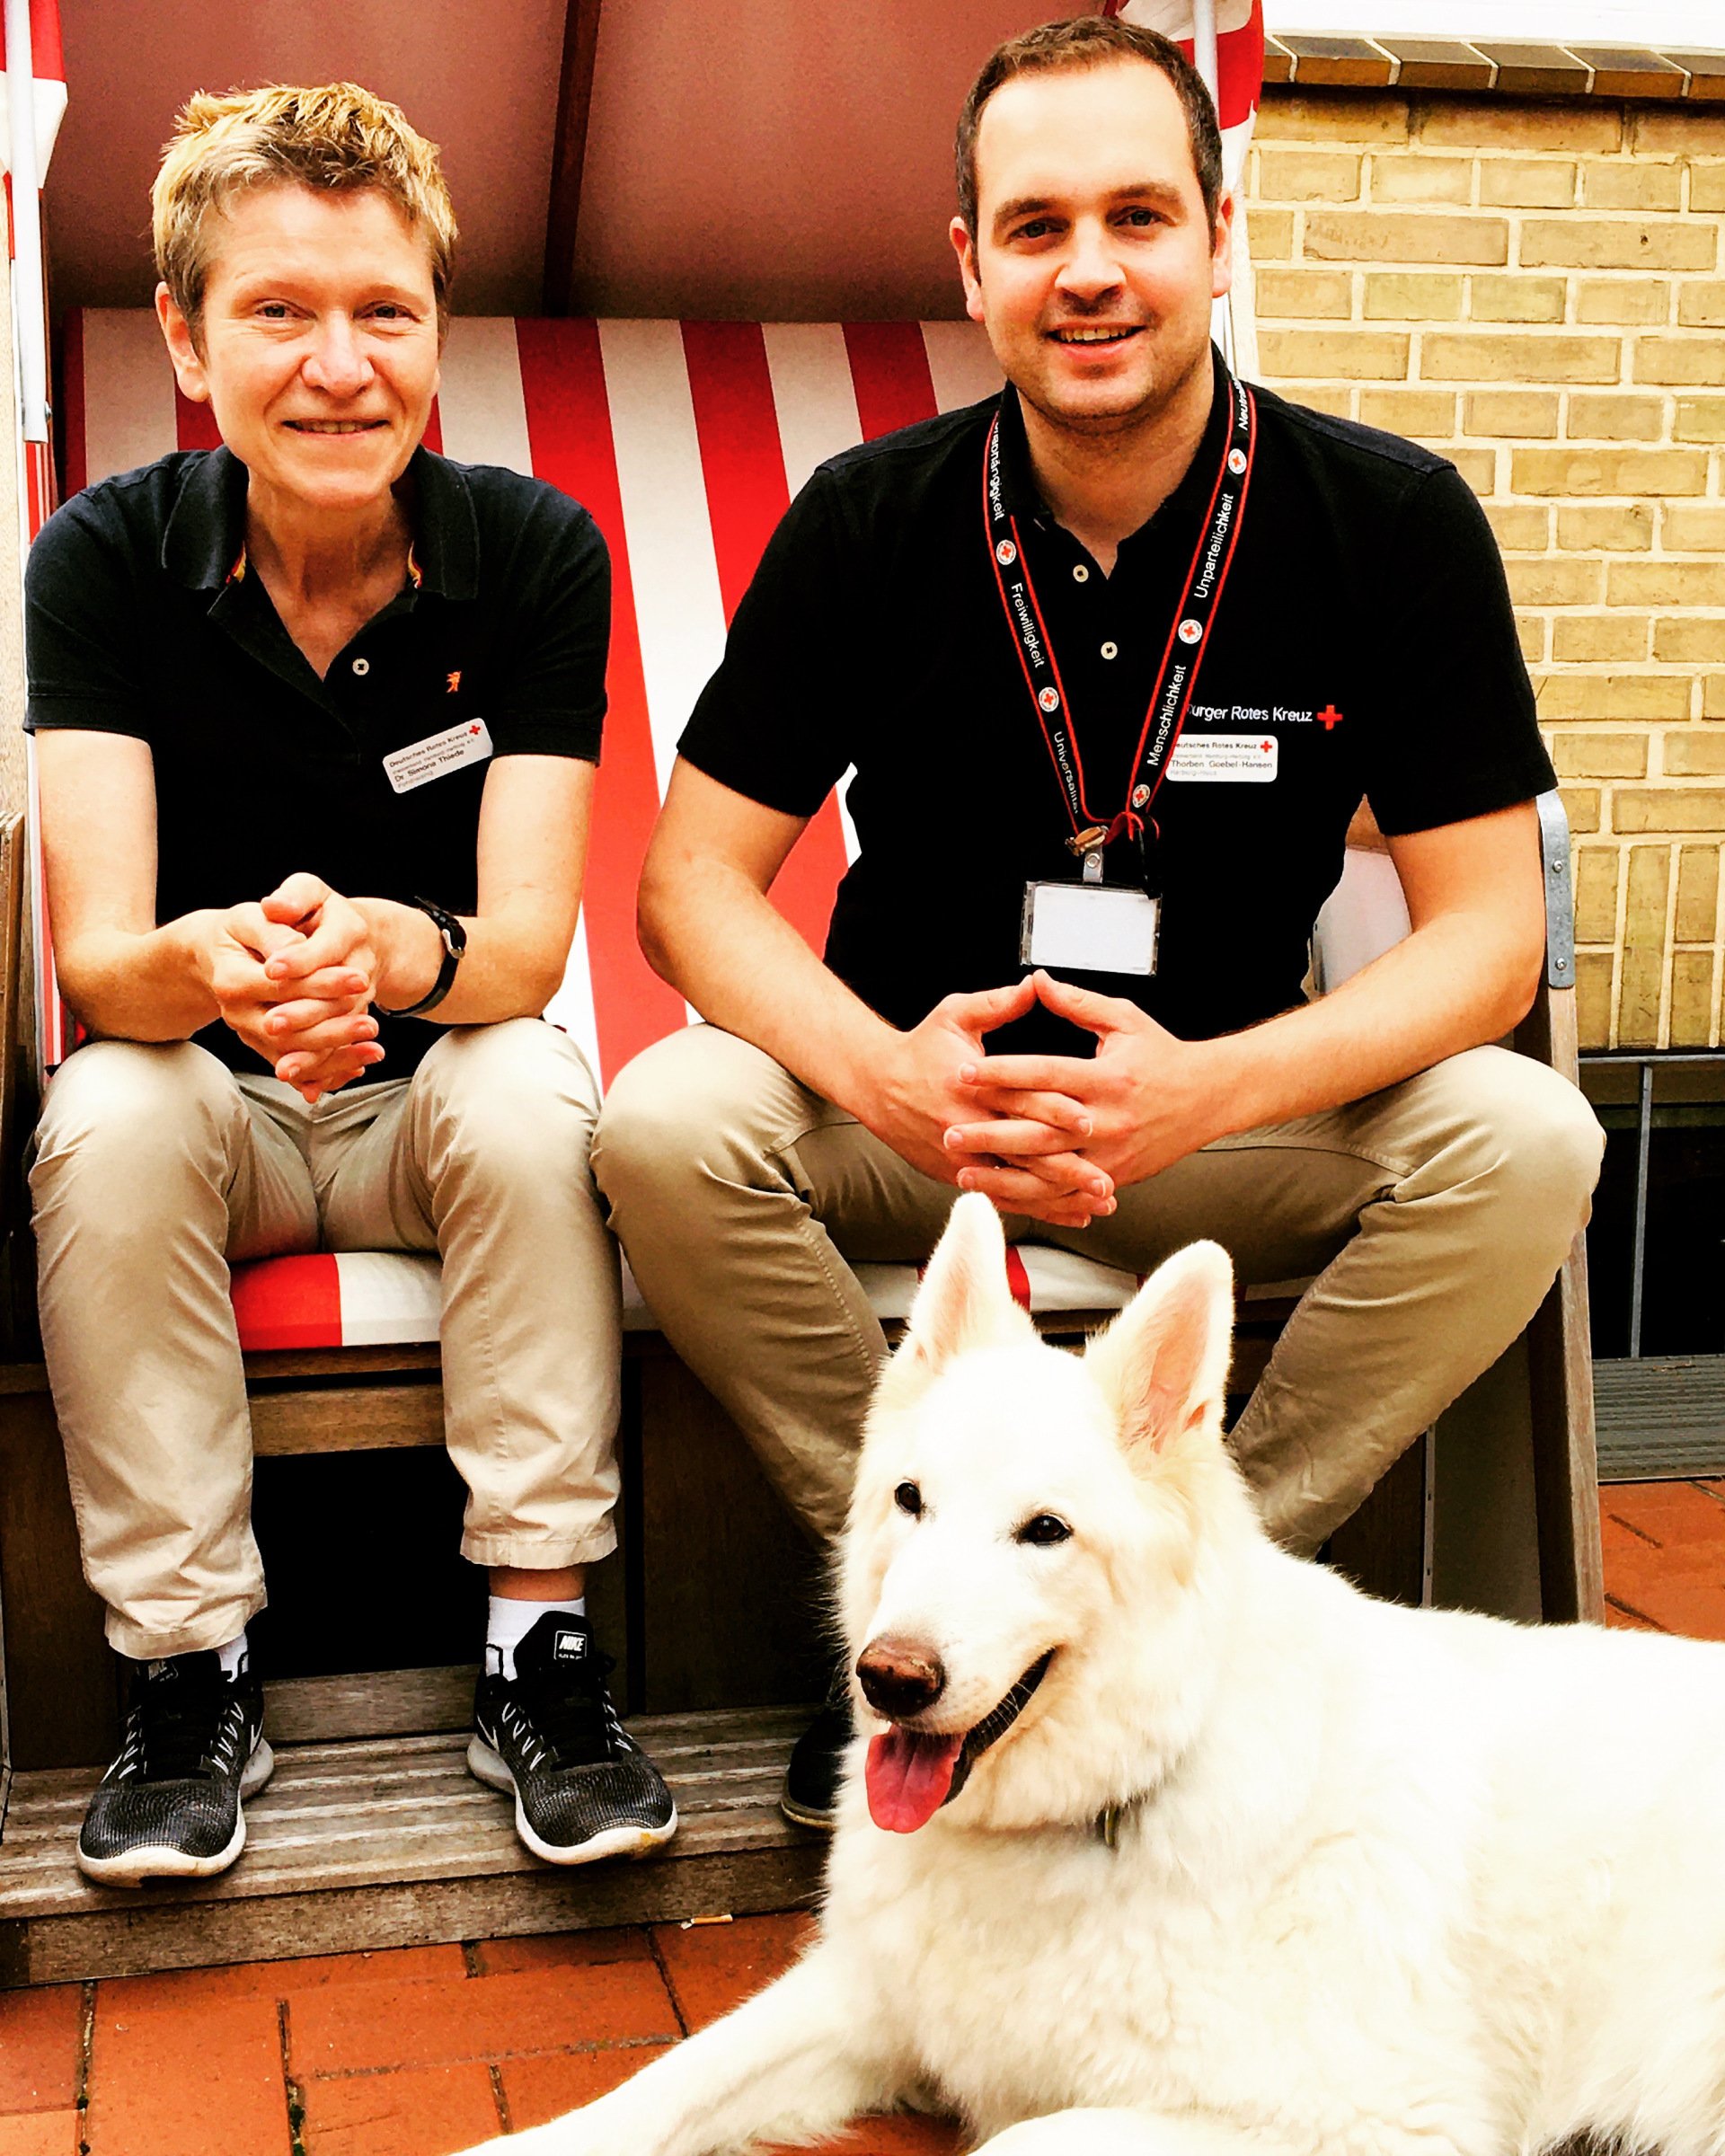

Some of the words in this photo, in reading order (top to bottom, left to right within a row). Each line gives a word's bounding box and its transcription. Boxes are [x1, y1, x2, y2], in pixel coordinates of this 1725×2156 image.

[1193, 492, 1234, 599] Unparteilichkeit
[1011, 582, 1045, 668] Freiwilligkeit
[1146, 665, 1187, 766] Menschlichkeit
[1231, 706, 1269, 720] Rotes
[1272, 706, 1314, 722] Kreuz
[1171, 760, 1204, 768] Thorben
[558, 1634, 585, 1652] NIKE
